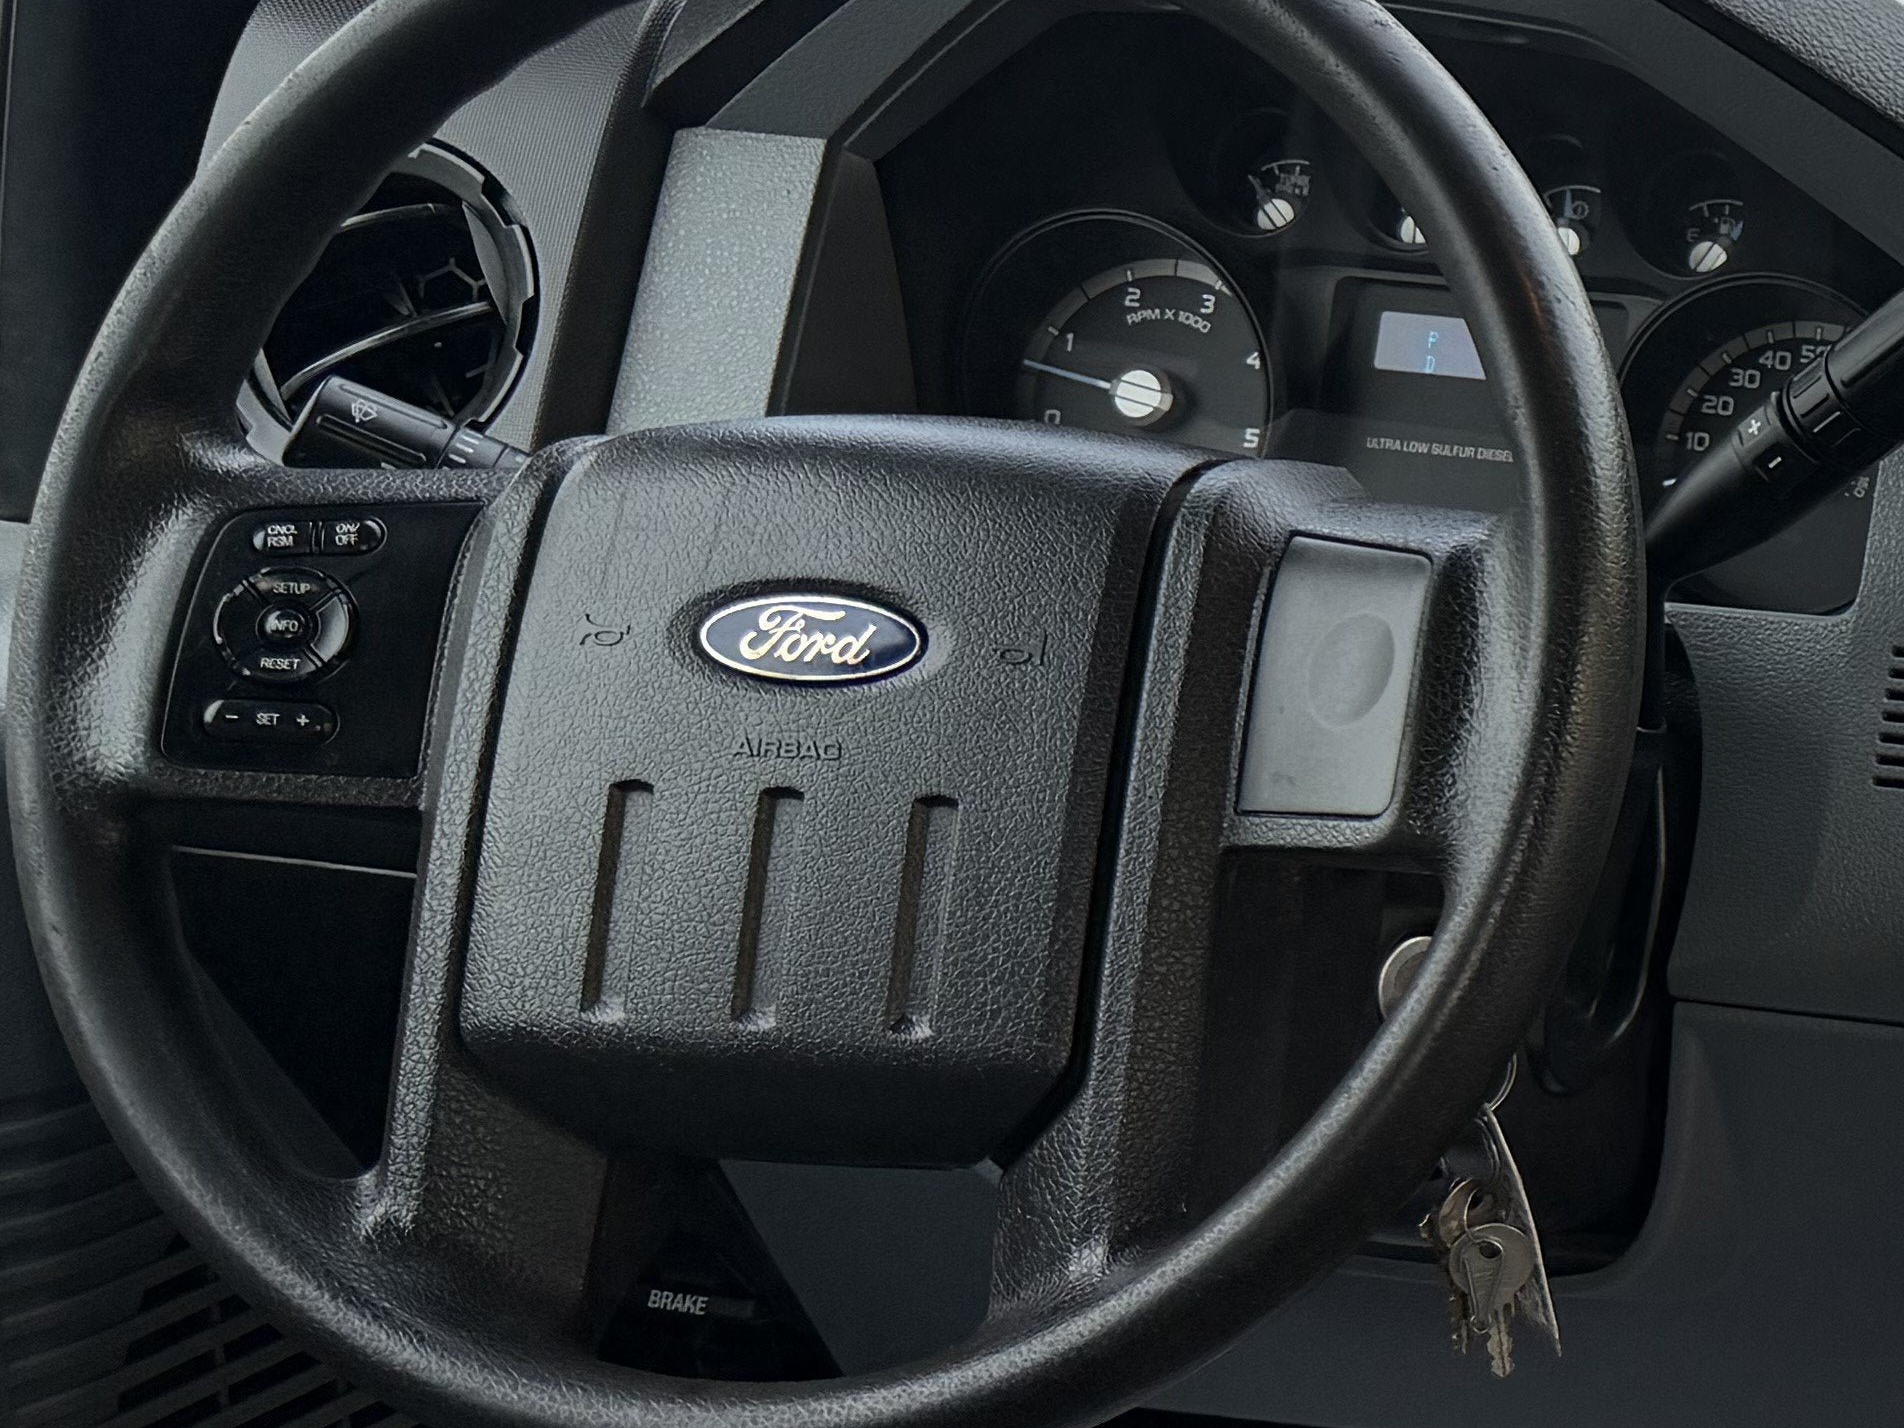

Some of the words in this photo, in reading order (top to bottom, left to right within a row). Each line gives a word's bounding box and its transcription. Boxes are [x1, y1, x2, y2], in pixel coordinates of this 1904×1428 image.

[1124, 287, 1141, 308] 2
[1200, 293, 1216, 315] 3
[1126, 307, 1161, 327] RPM
[1178, 310, 1212, 334] 1000
[1065, 331, 1075, 352] 1
[1245, 350, 1261, 370] 4
[1758, 350, 1792, 372] 40
[1728, 368, 1762, 390] 30
[1700, 394, 1735, 418] 20
[1242, 427, 1261, 449] 5
[1366, 437, 1401, 451] ULTRA
[1402, 440, 1430, 454] LOW
[1431, 442, 1475, 459] SULFUR
[1685, 431, 1711, 452] 10
[267, 524, 298, 535] CNCL
[334, 534, 359, 546] OFF
[266, 535, 295, 548] RSM
[272, 581, 312, 595] SETUP
[269, 619, 299, 633] INFO
[738, 604, 878, 665] Ford
[260, 657, 301, 671] RESET
[255, 712, 281, 726] SET
[732, 735, 844, 761] AIRBAG
[647, 1288, 710, 1316] BRAKE
